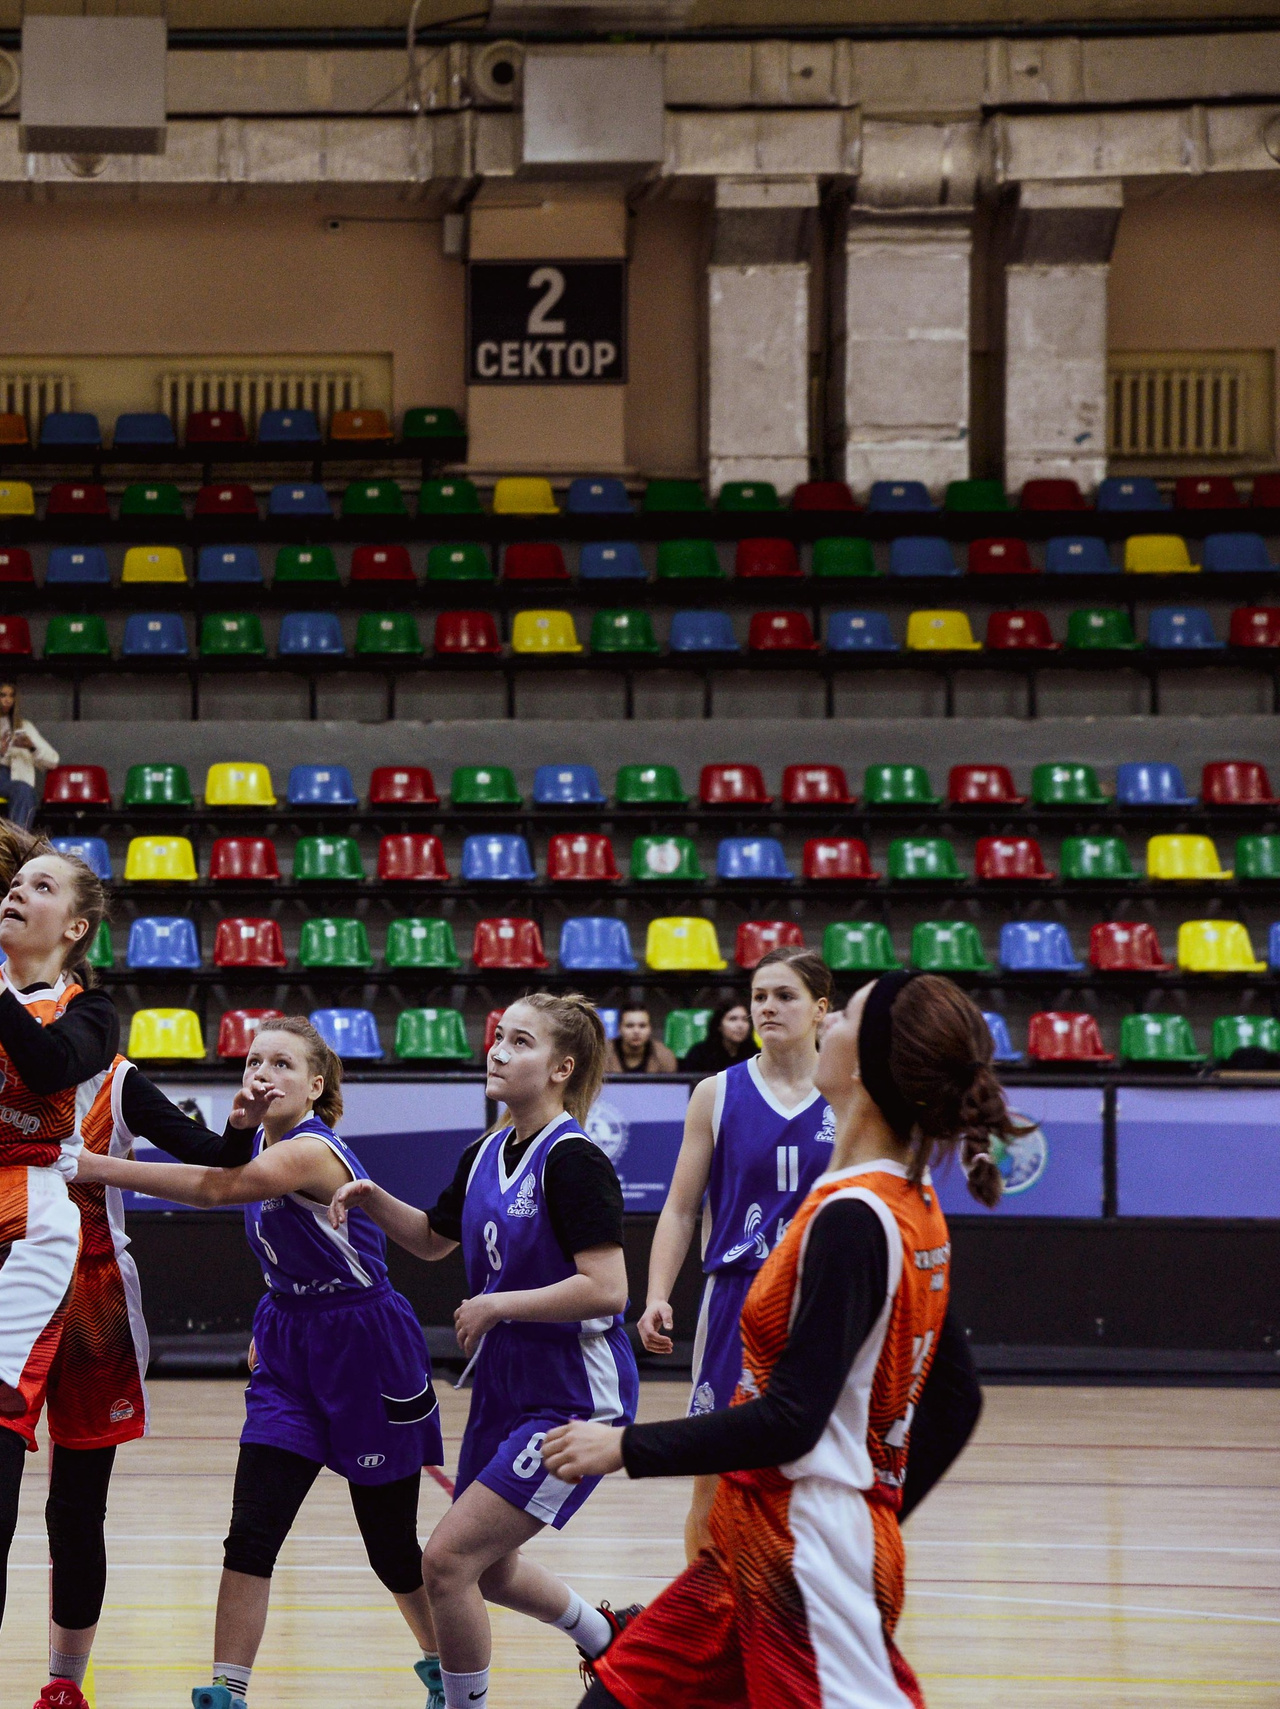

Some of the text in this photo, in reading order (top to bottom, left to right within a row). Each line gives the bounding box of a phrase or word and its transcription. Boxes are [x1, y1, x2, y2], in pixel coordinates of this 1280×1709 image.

[526, 267, 566, 334] 2
[476, 341, 616, 377] СЕКТОР
[776, 1145, 799, 1192] 11
[483, 1220, 502, 1271] 8
[512, 1432, 548, 1479] 8
